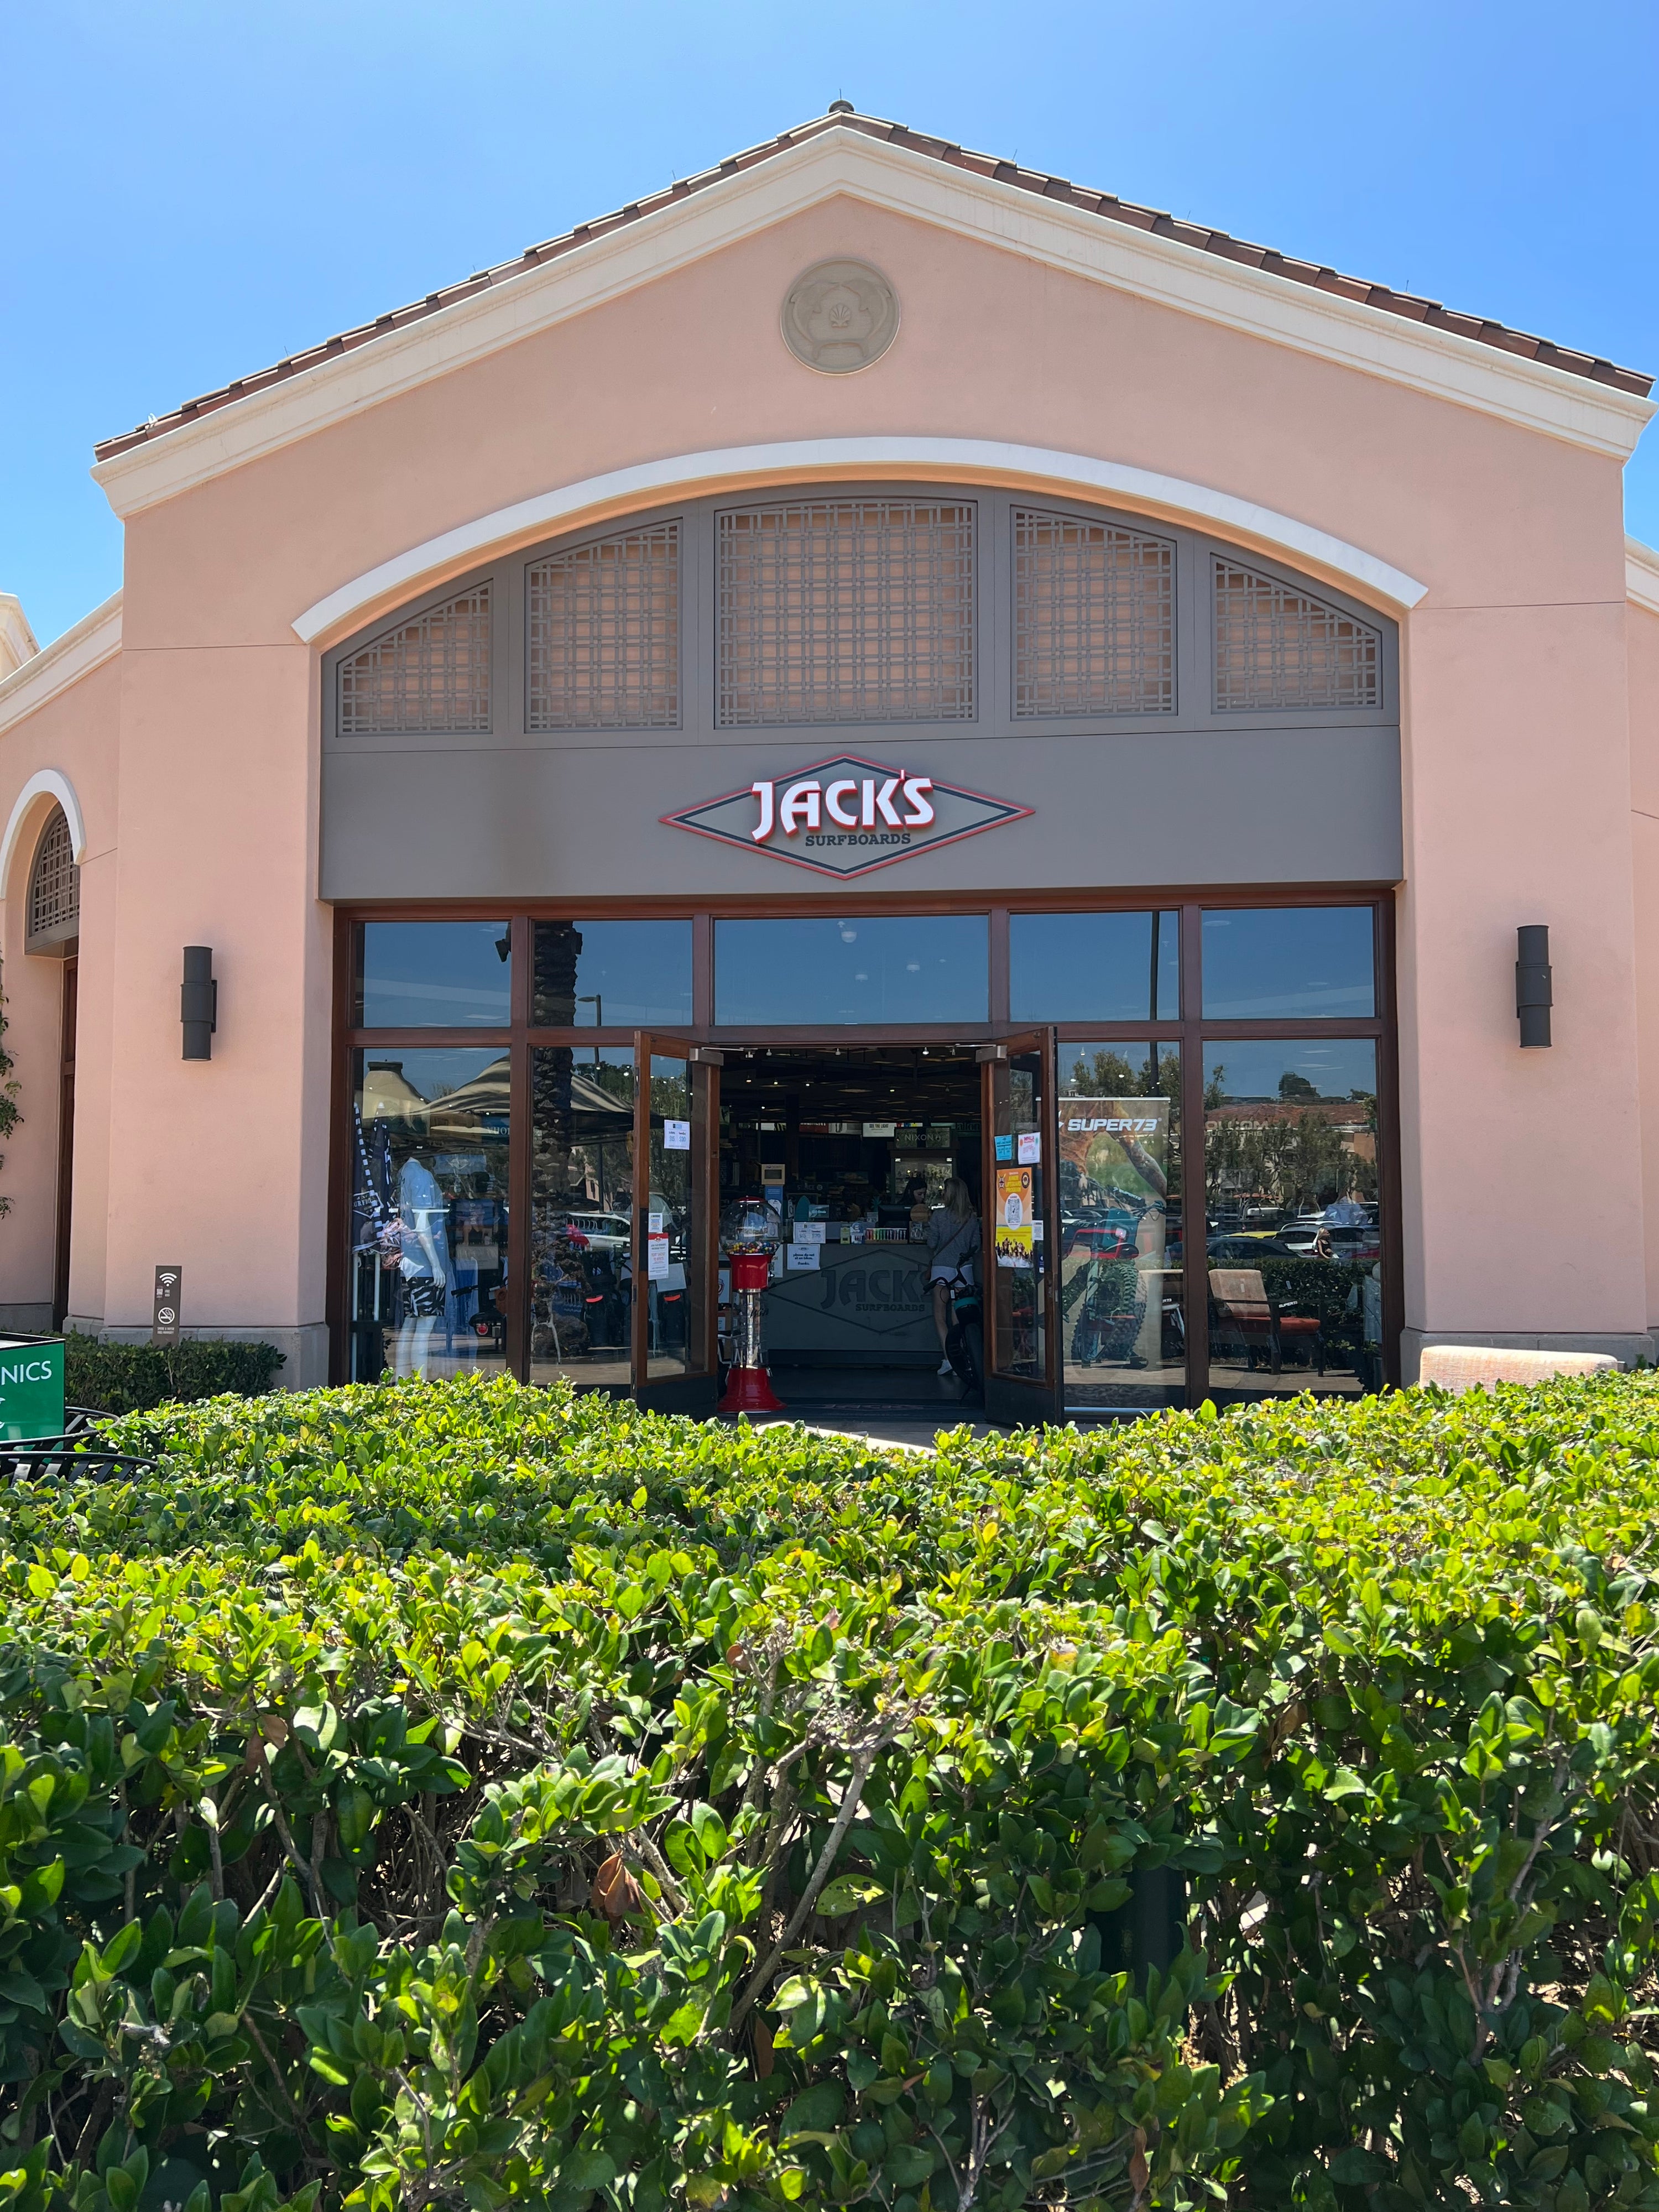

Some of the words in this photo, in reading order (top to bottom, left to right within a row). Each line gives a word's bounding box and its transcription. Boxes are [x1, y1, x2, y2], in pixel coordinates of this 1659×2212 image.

[751, 769, 935, 844] JACK'S
[805, 833, 911, 847] SURFBOARDS
[1067, 1118, 1158, 1132] SUPER73
[855, 1303, 925, 1312] SURFBOARDS
